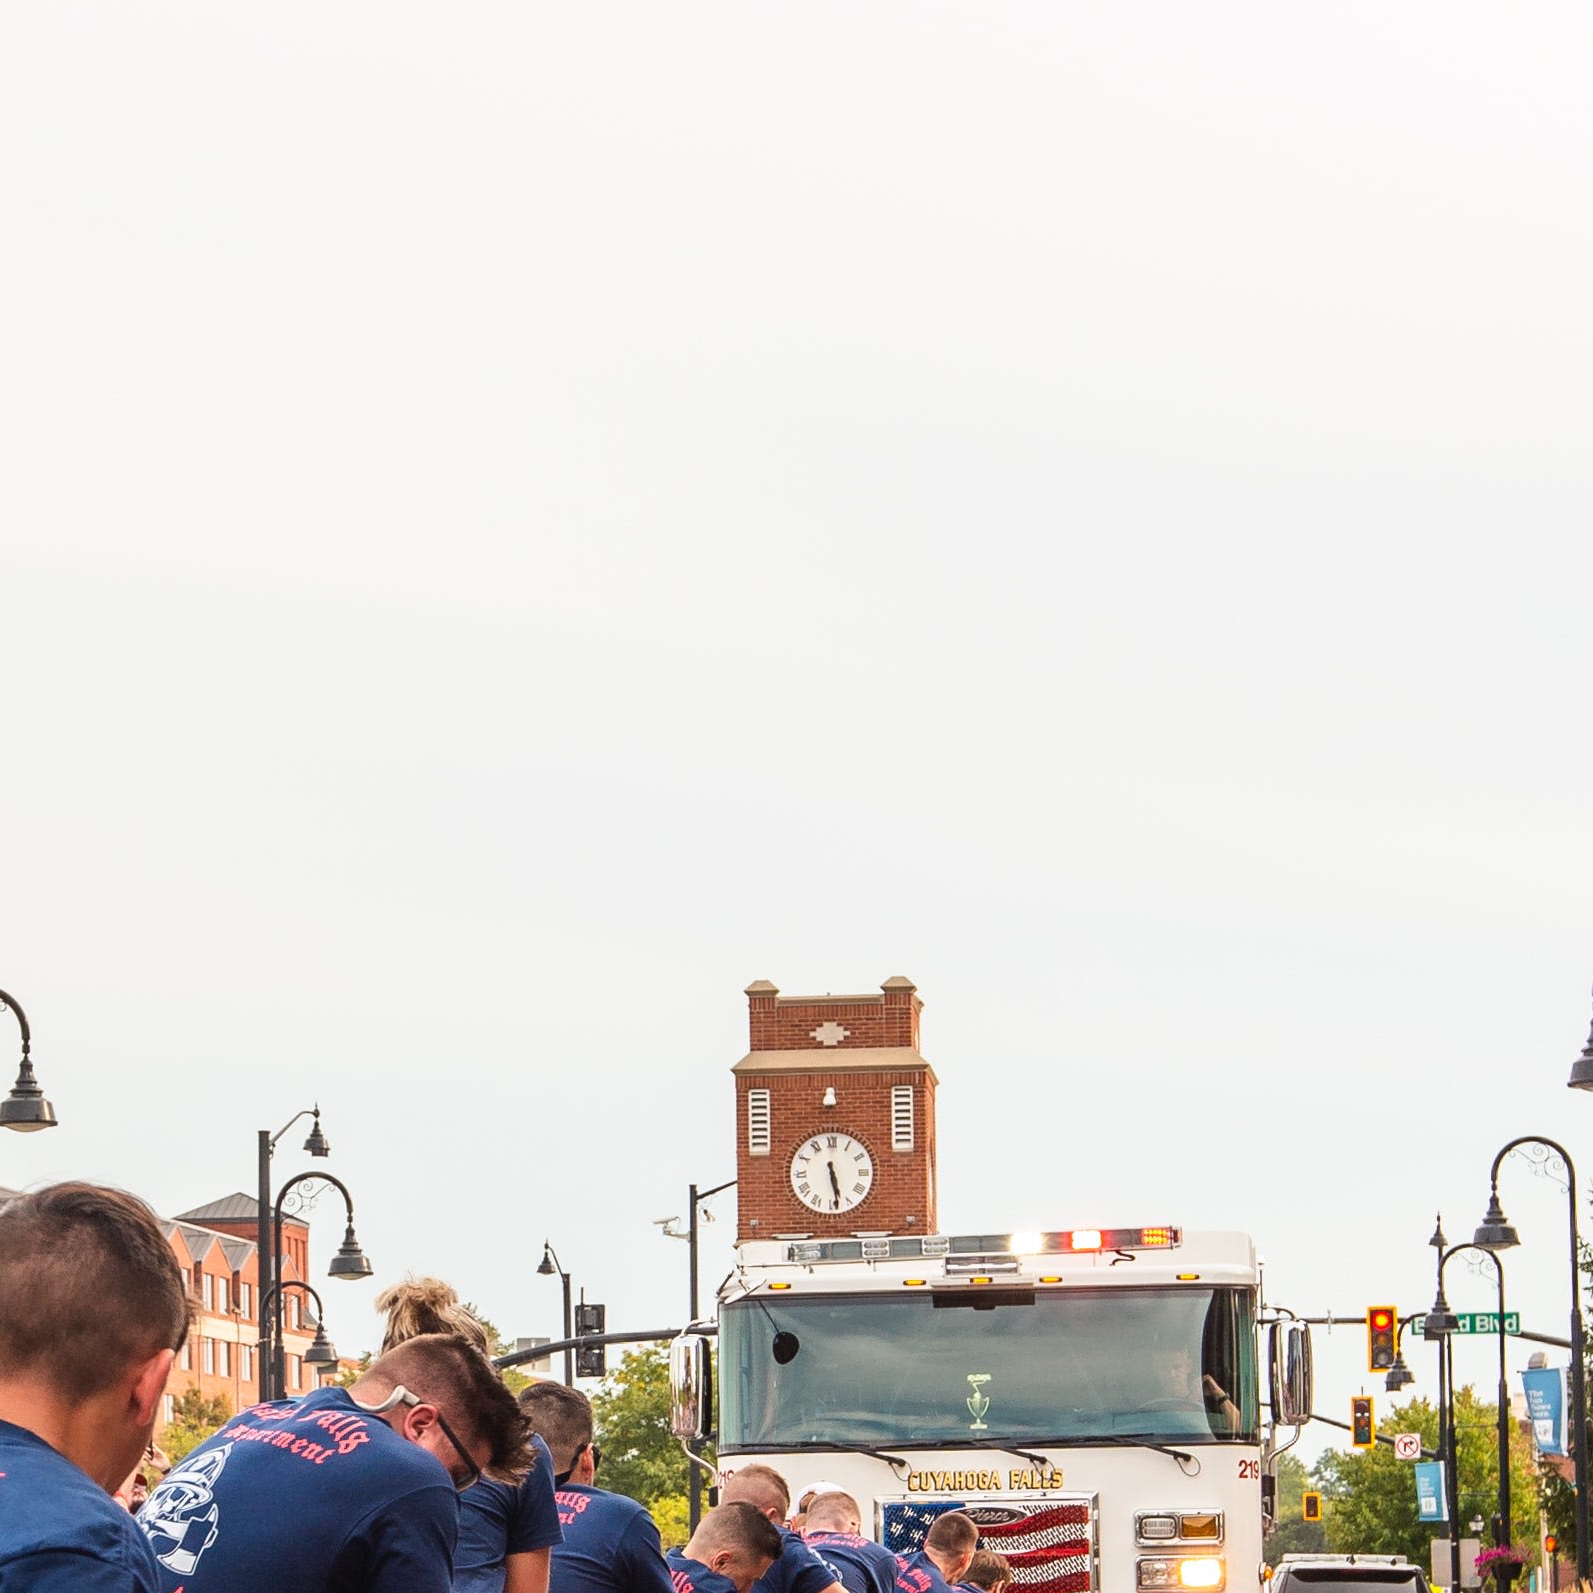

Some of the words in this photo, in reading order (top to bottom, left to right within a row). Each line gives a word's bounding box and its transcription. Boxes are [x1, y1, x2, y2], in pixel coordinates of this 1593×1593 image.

[908, 1470, 1002, 1492] CUYAHOGA
[1009, 1468, 1064, 1491] FALLS
[1238, 1459, 1260, 1480] 219
[555, 1491, 592, 1514] alls
[965, 1508, 1010, 1523] Pierce
